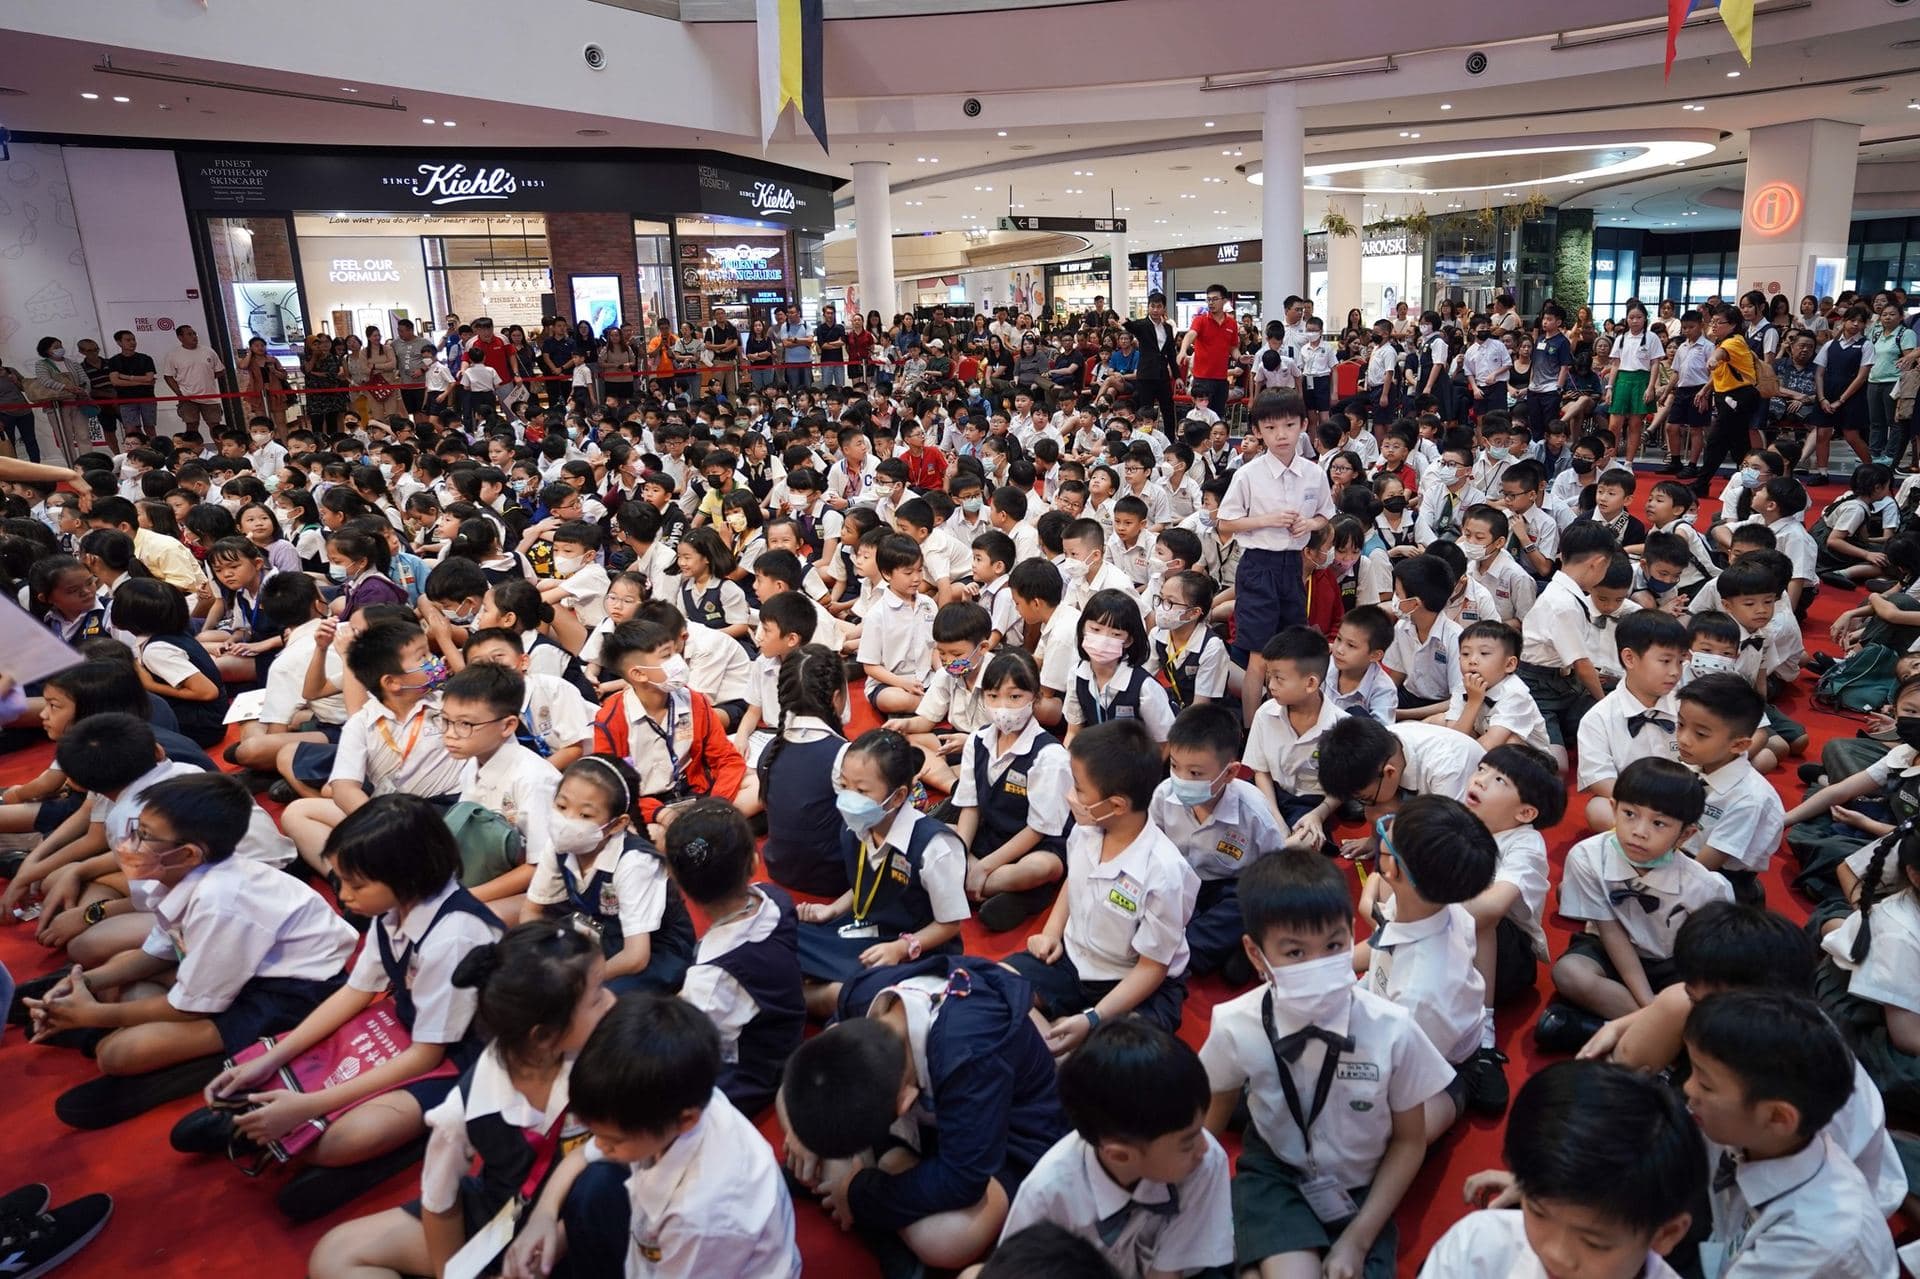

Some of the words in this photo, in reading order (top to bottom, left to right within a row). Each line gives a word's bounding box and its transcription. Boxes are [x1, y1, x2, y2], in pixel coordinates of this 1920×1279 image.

[214, 159, 253, 168] FINEST
[200, 168, 270, 177] APOTHECARY
[209, 176, 263, 186] SKINCARE
[382, 177, 418, 185] SINCE
[412, 163, 517, 196] Kiehl's
[521, 179, 546, 187] 1851
[752, 182, 796, 209] Kiehl's
[329, 216, 350, 224] Love
[352, 216, 373, 224] what
[1217, 244, 1239, 258] AWG
[333, 259, 362, 271] FEEL
[364, 259, 393, 271] OUR
[329, 271, 400, 282] FORMULAS
[134, 317, 150, 325] FIRE
[136, 324, 153, 332] HOSE
[865, 474, 872, 486] C
